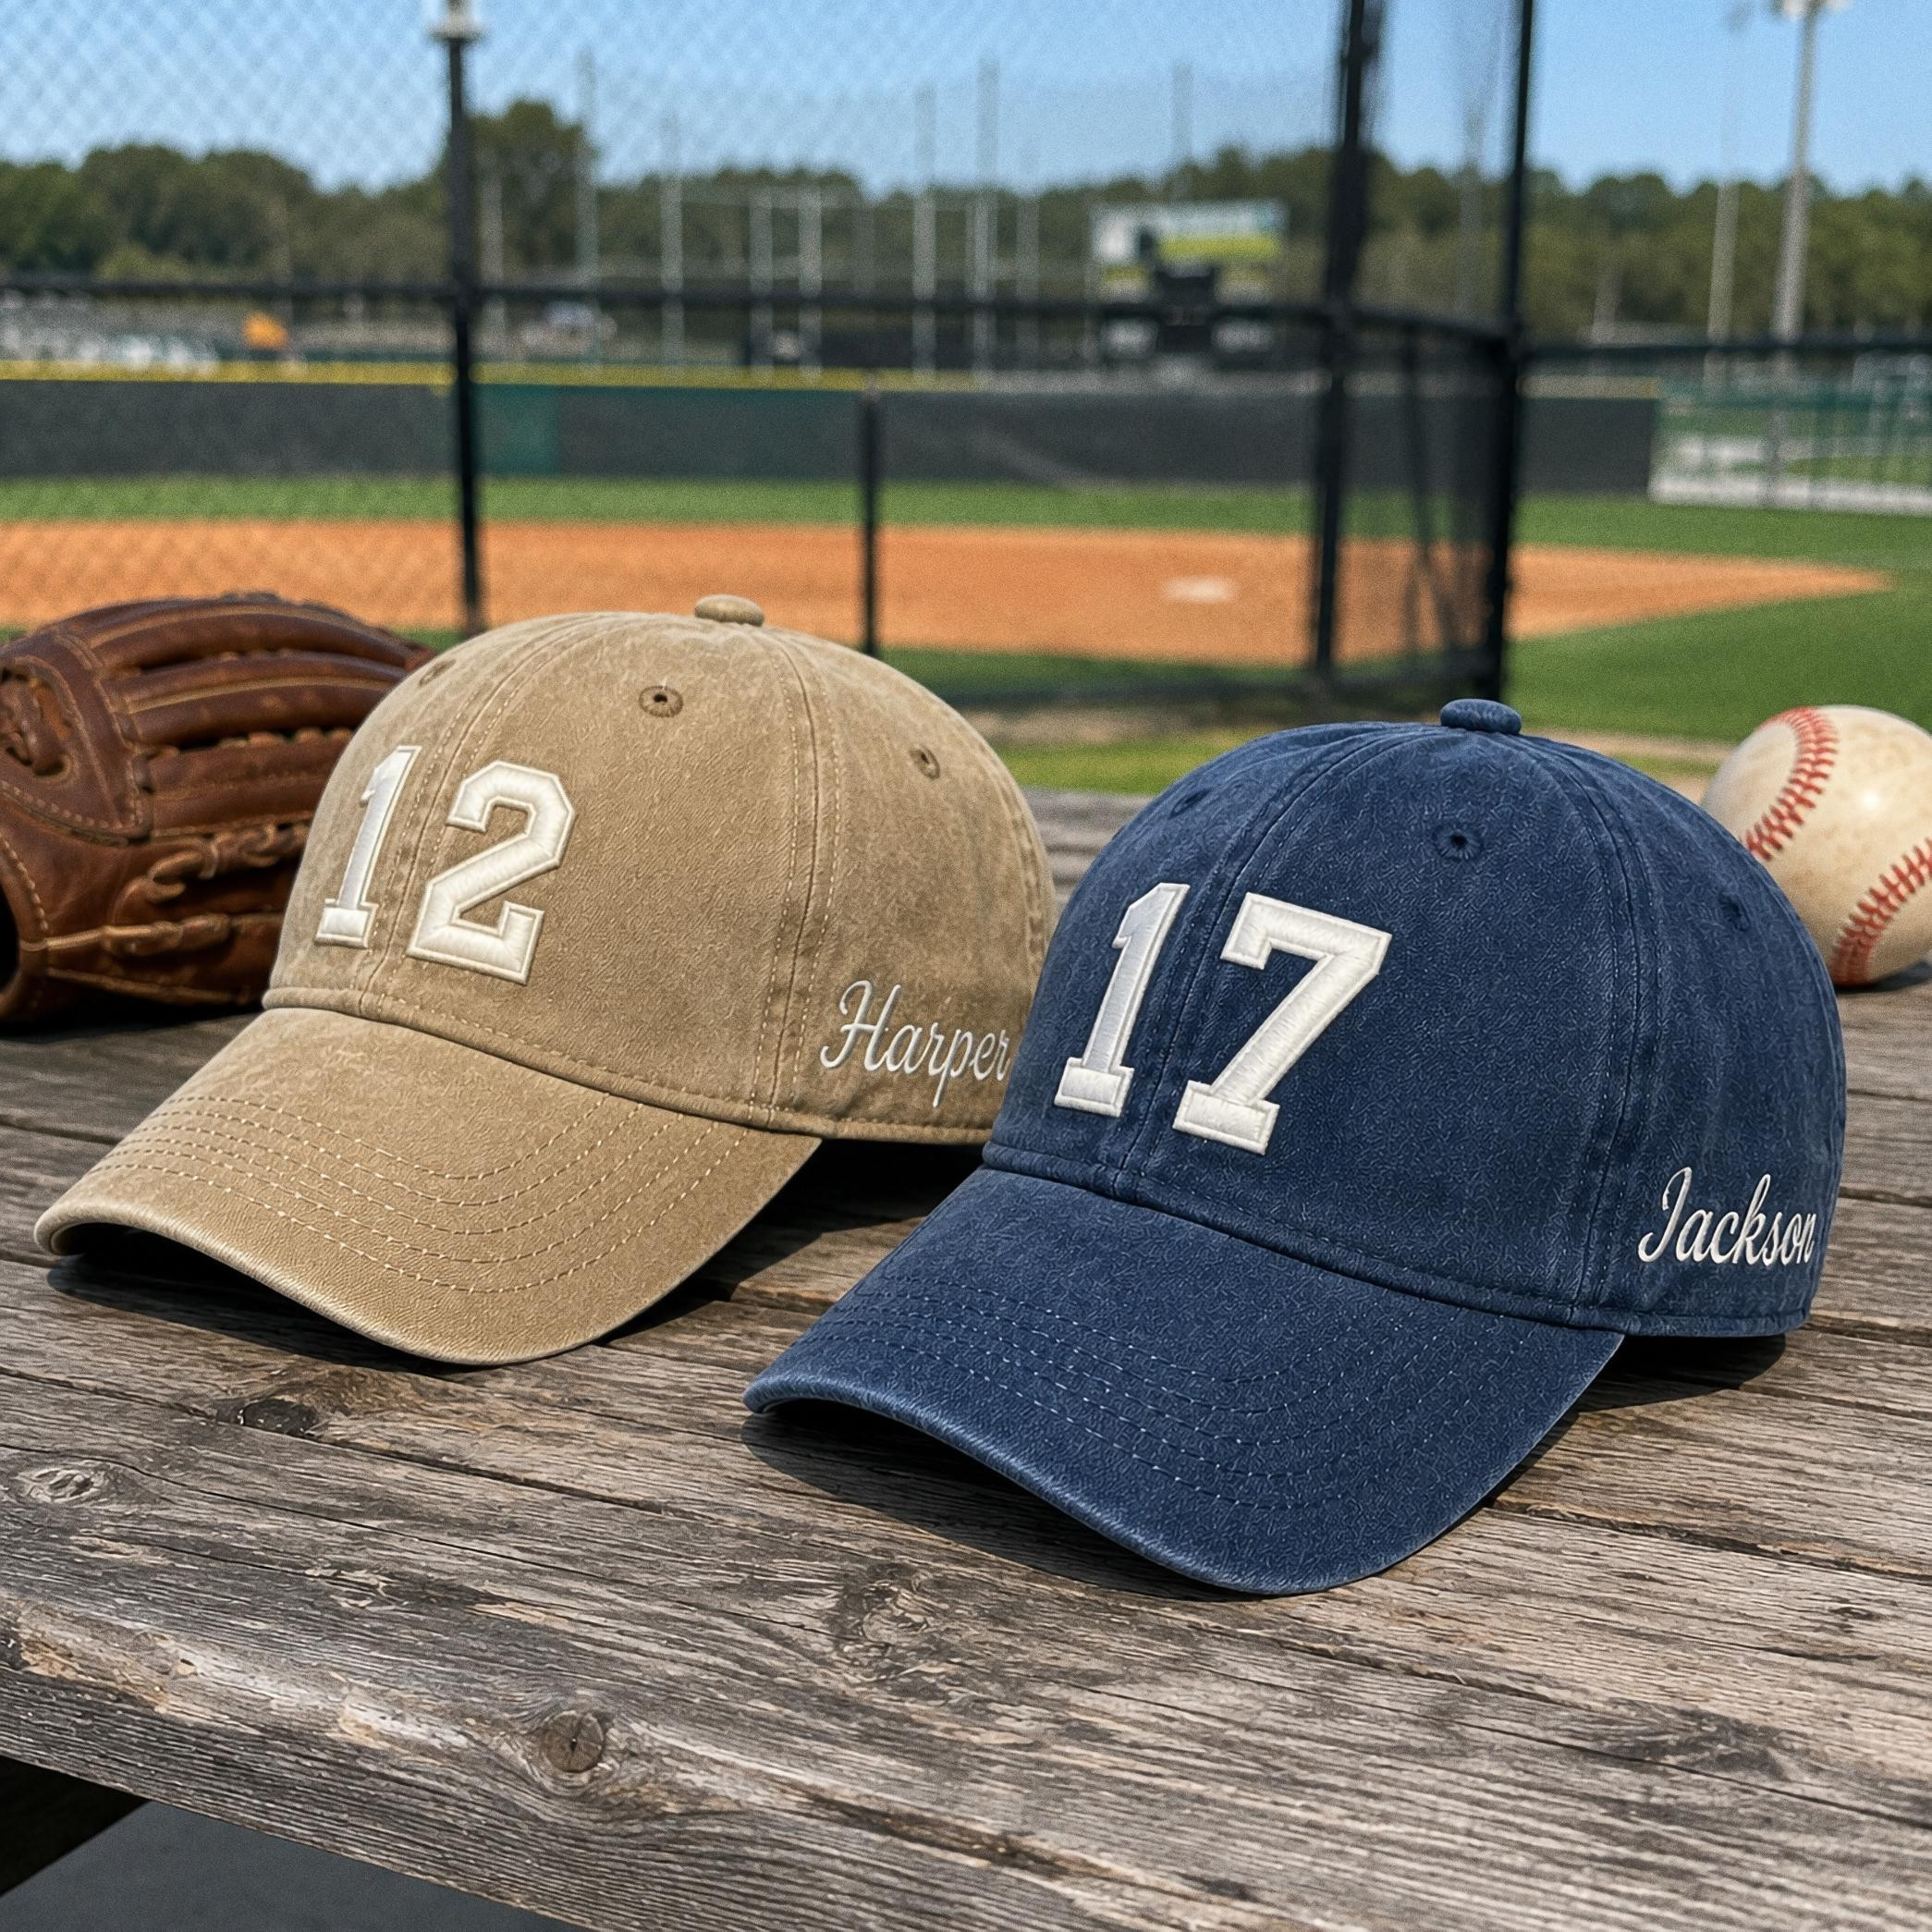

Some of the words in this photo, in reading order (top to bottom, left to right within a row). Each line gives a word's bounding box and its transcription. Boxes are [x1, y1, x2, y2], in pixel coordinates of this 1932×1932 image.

[314, 745, 575, 985] 12
[820, 980, 1012, 1107] Harper
[1054, 882, 1392, 1155] 17
[1637, 1167, 1816, 1266] Jackson
